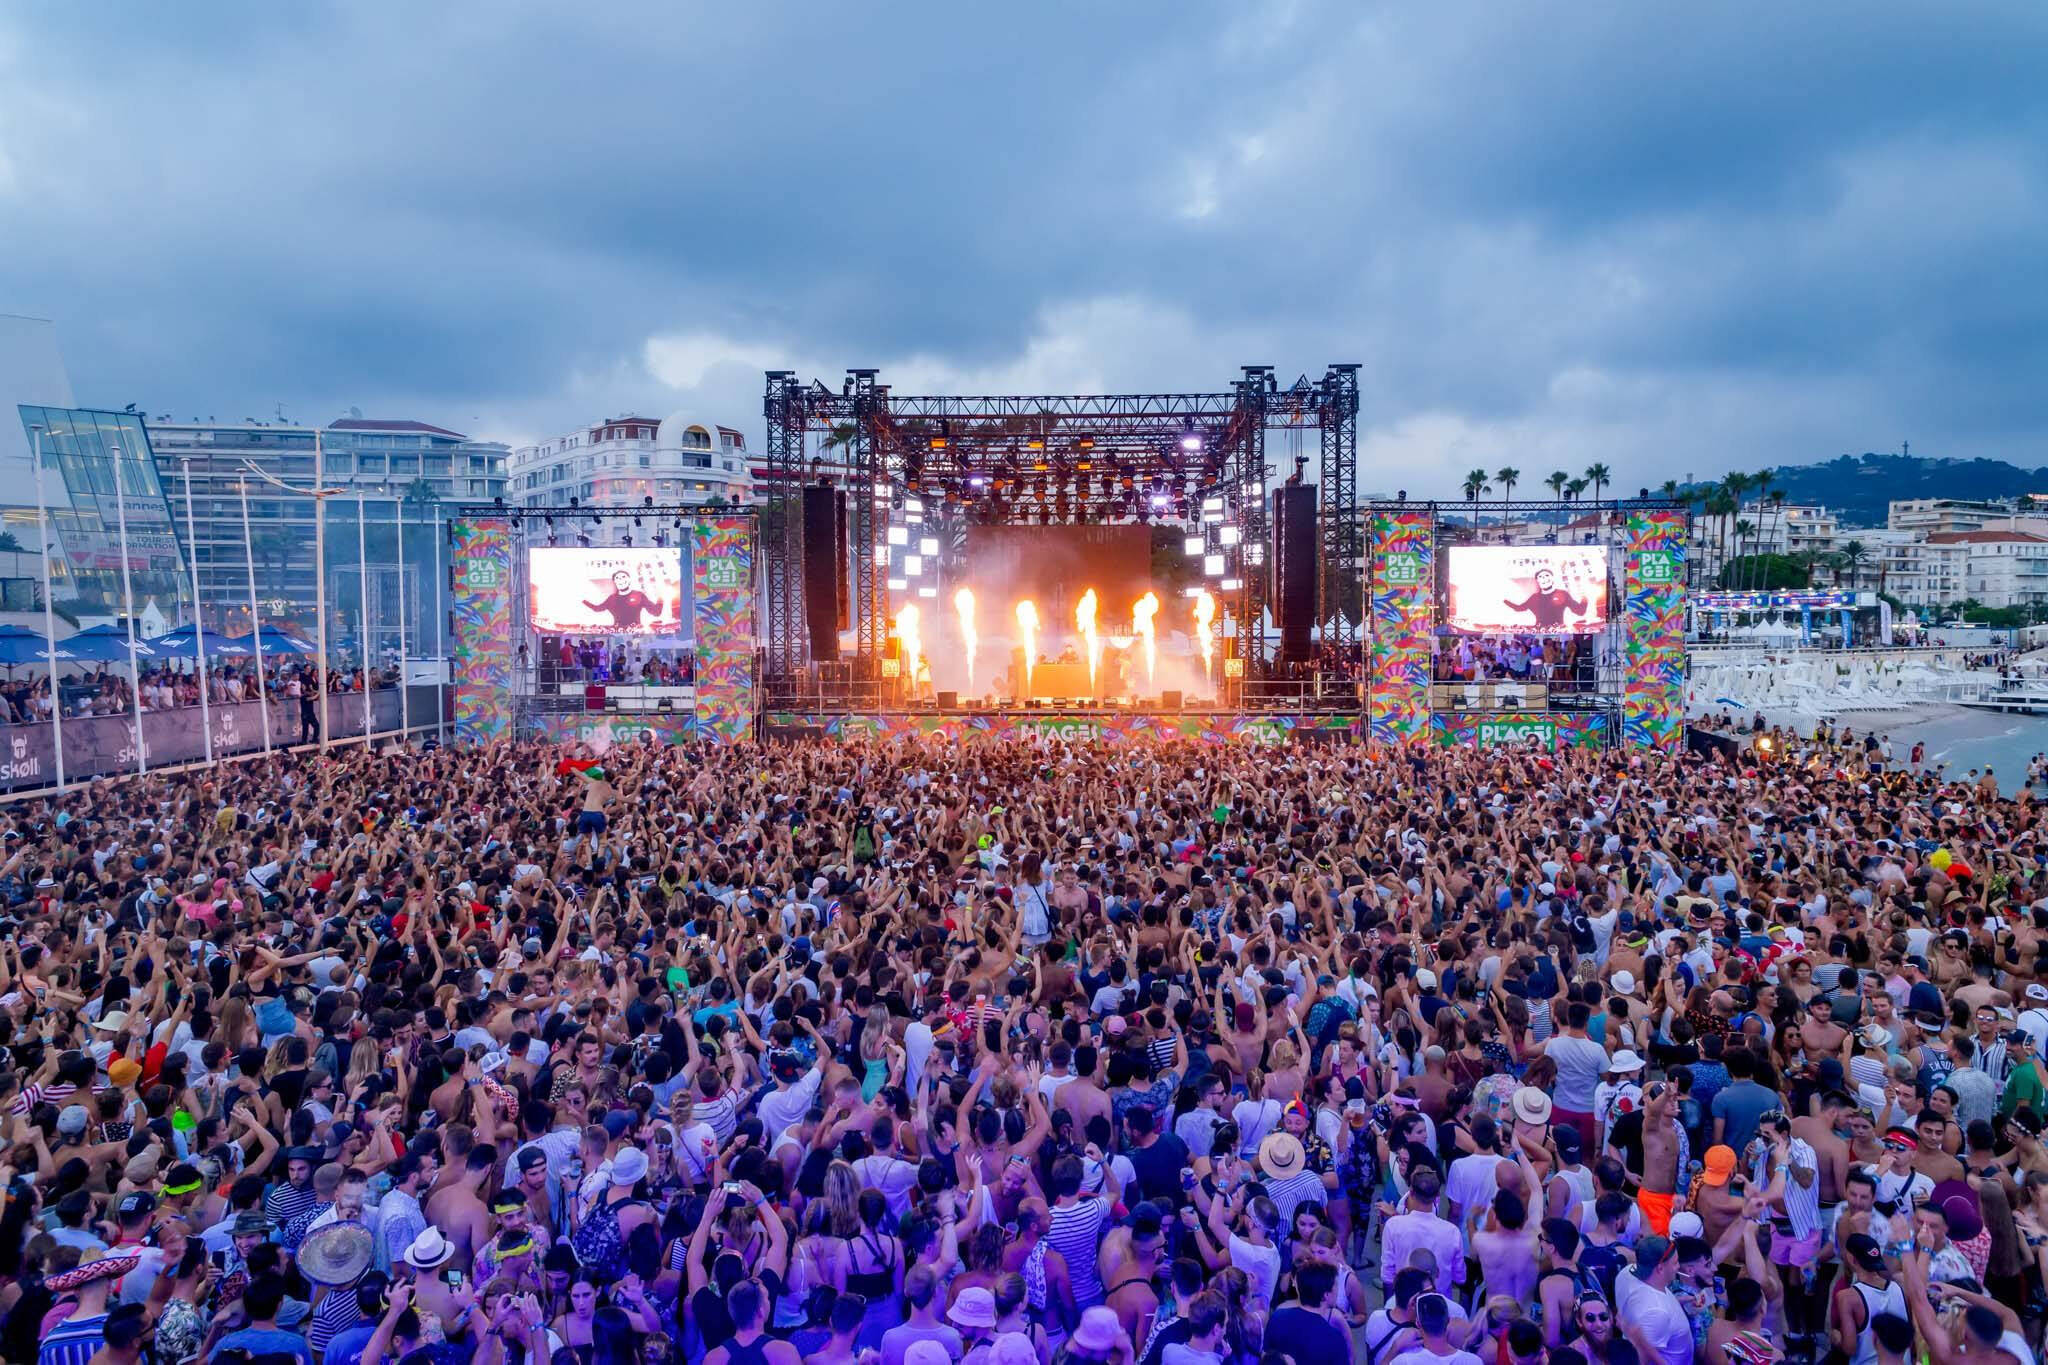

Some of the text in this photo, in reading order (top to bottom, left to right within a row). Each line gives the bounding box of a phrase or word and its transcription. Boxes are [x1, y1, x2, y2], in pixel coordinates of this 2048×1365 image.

[469, 559, 496, 571] PLA
[709, 559, 736, 571] PLA
[1388, 555, 1416, 566] PLA
[1642, 553, 1670, 565] PLA
[469, 571, 496, 583] GES
[709, 571, 736, 583] GES
[1388, 566, 1416, 578] GES
[1642, 566, 1671, 577] GES
[1481, 725, 1552, 741] PLAGES
[0, 757, 39, 780] skøll
